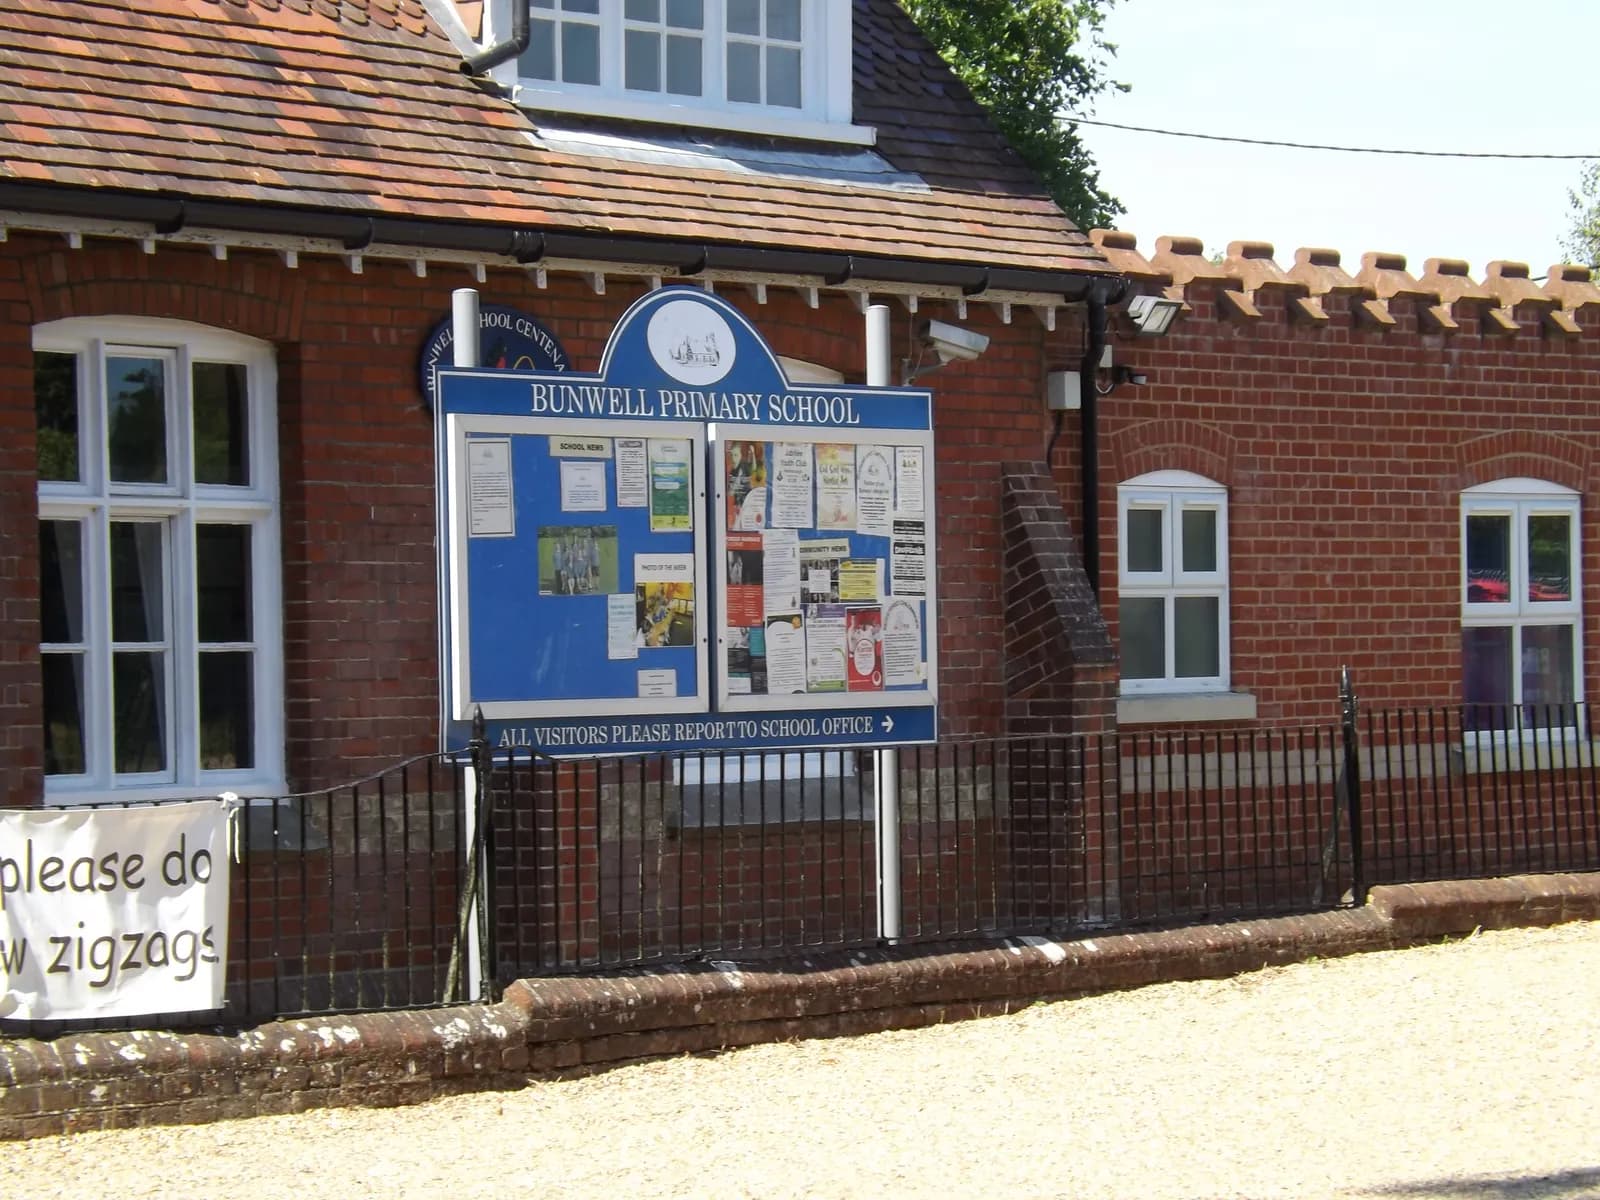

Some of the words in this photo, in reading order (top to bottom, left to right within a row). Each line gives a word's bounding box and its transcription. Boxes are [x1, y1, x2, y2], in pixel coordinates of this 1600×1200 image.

[480, 312, 513, 330] HOOL
[516, 318, 565, 373] CENTENA
[531, 383, 654, 416] BUNWELL
[659, 389, 761, 421] PRIMARY
[768, 394, 860, 424] SCHOOL
[560, 442, 585, 451] SCHOOL
[587, 444, 604, 452] NEWS
[499, 728, 531, 747] ALL
[534, 725, 609, 746] VISITORS
[612, 723, 671, 743] PLEASE
[675, 720, 736, 741] REPORT
[735, 720, 757, 738] TO
[760, 718, 820, 737] SCHOOL
[822, 716, 873, 735] OFFICE
[0, 838, 145, 910] please
[162, 832, 212, 886] do
[47, 921, 219, 987] zigzags
